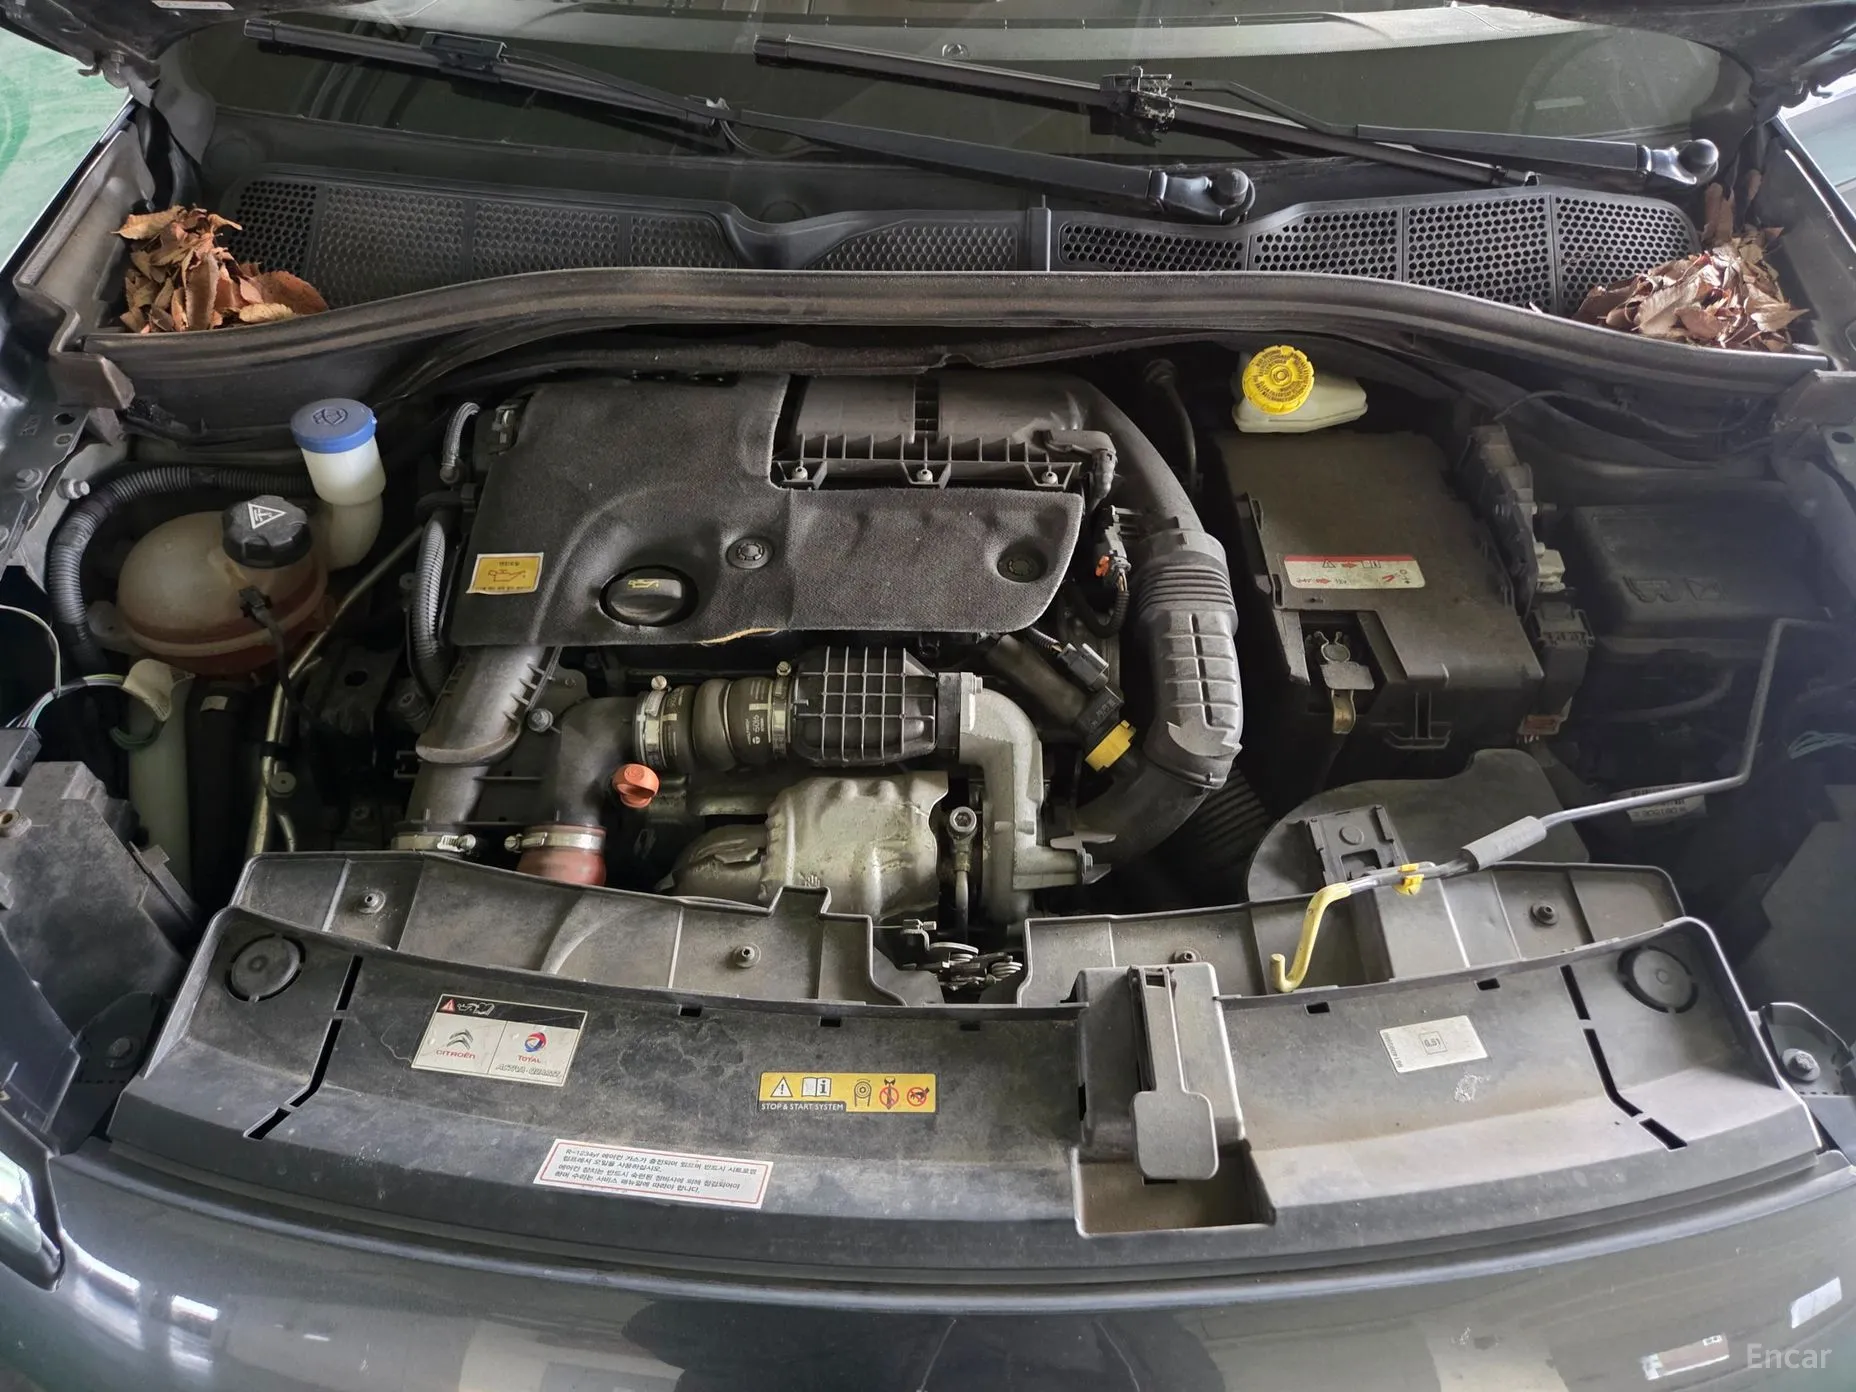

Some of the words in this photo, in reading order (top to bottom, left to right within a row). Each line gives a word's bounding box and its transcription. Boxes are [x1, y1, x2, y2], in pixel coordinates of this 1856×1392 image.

[518, 1055, 542, 1063] TOTAL
[761, 1103, 782, 1111] STOP
[790, 1103, 812, 1111] START
[815, 1103, 844, 1111] SYSTEM
[704, 1164, 726, 1172] 반드시
